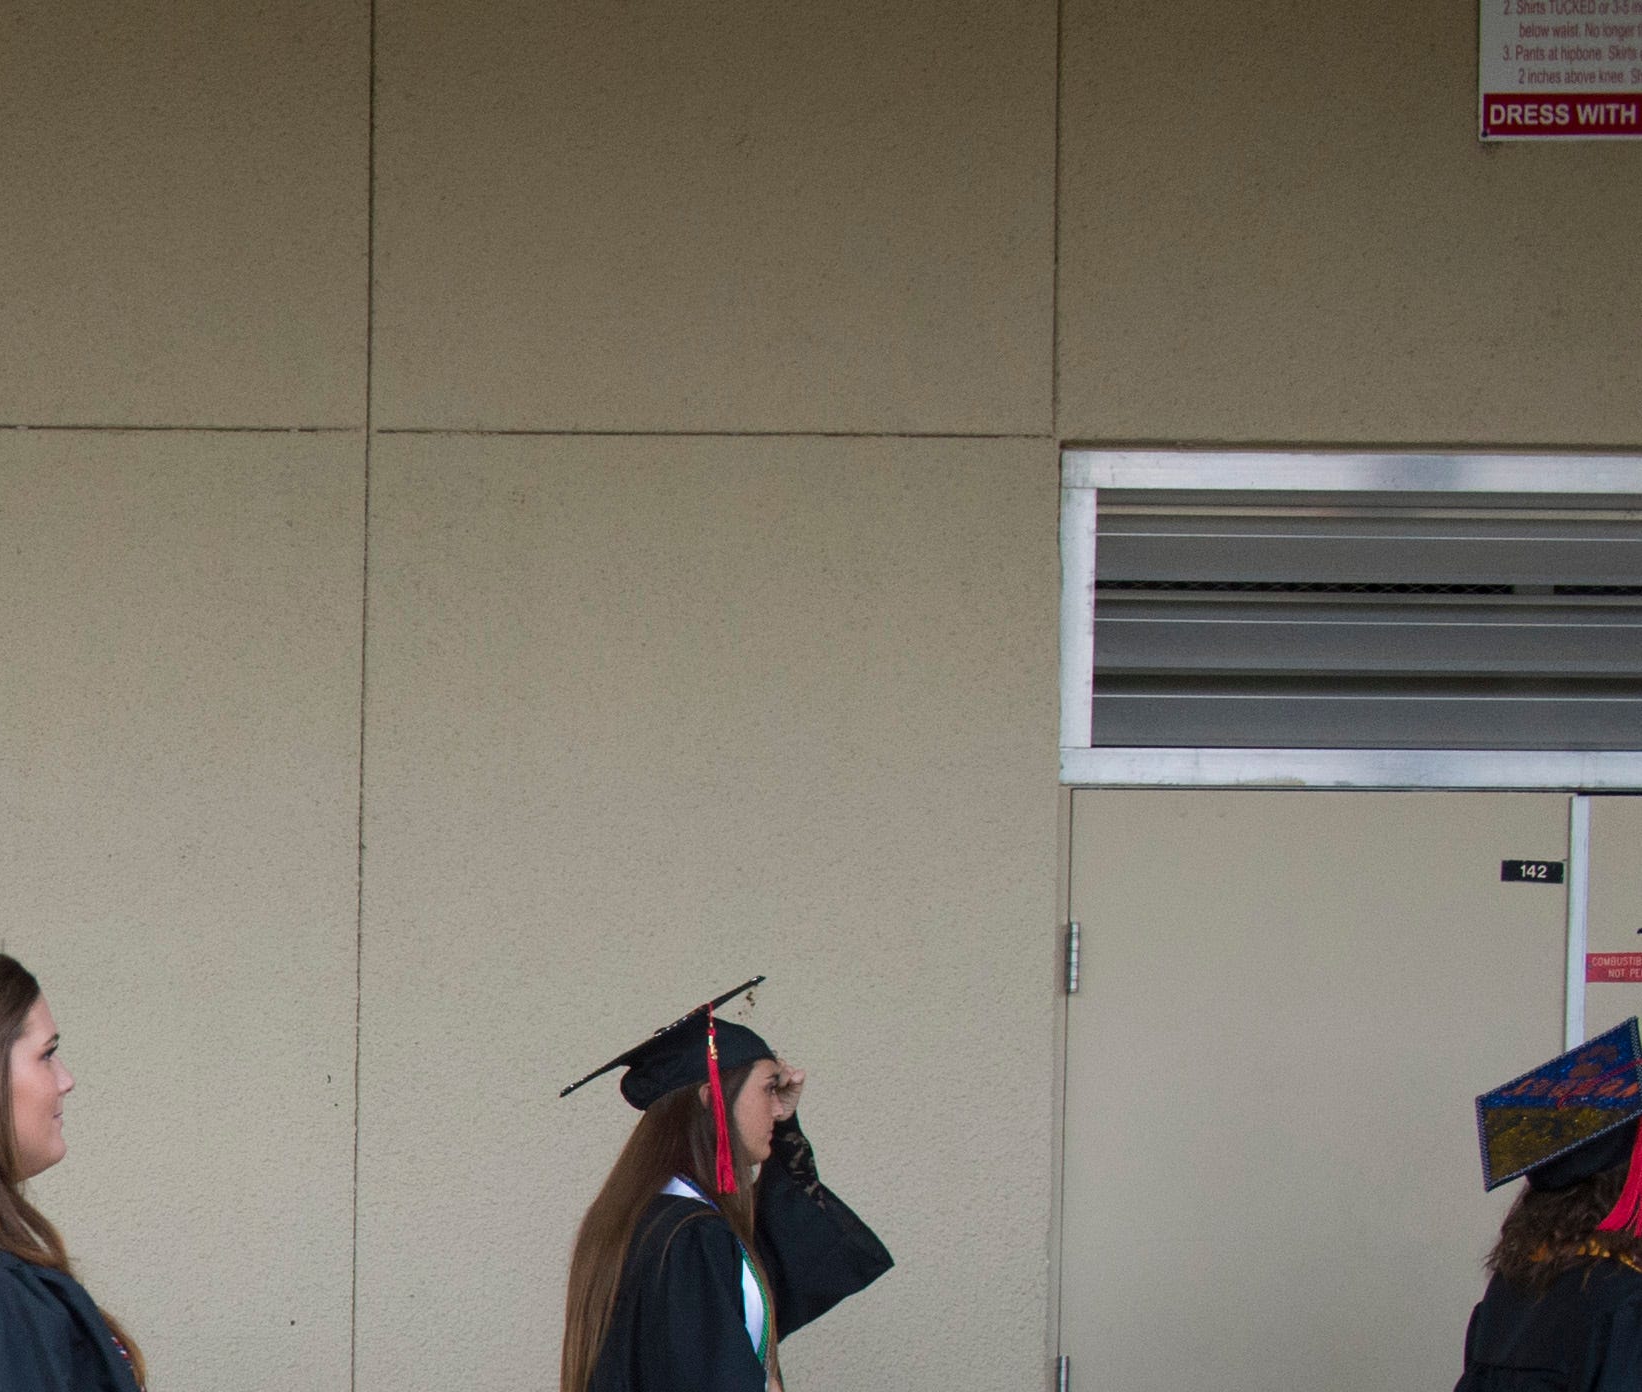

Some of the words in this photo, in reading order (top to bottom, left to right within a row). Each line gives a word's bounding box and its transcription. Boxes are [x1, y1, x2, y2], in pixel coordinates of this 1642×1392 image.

[1516, 0, 1546, 15] Shirts
[1549, 0, 1595, 15] TUCKED
[1598, 3, 1610, 15] or
[1519, 21, 1550, 38] below
[1584, 22, 1600, 38] No
[1602, 22, 1634, 42] longer
[1515, 44, 1545, 61] Pants
[1548, 45, 1558, 61] at
[1518, 67, 1525, 84] 2
[1527, 67, 1562, 84] inches
[1564, 67, 1596, 84] above
[1489, 103, 1570, 126] DRESS
[1575, 103, 1637, 126] WITH
[1520, 864, 1548, 879] 142
[1608, 967, 1625, 979] NOT
[1629, 967, 1642, 979] PE
